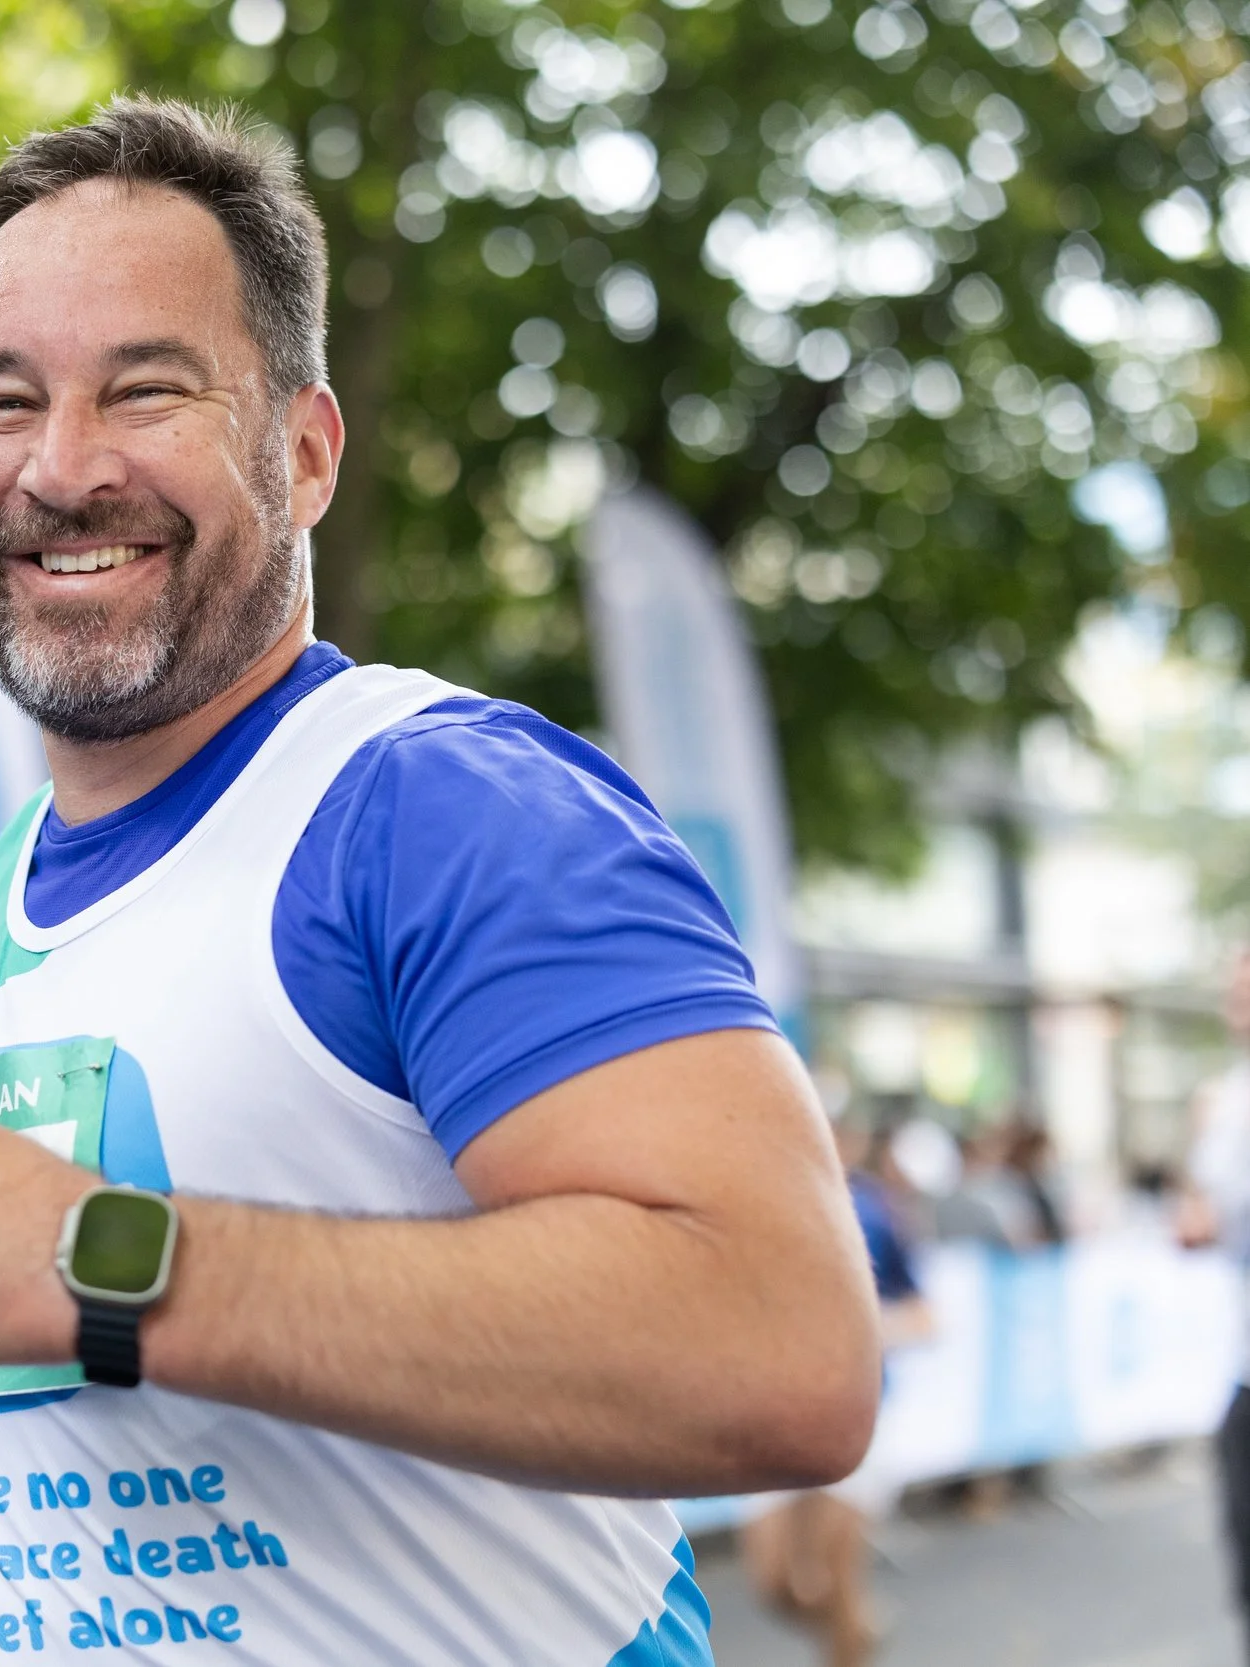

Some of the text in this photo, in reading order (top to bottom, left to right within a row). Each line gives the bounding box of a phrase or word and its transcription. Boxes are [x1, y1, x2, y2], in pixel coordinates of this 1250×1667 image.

[27, 1471, 91, 1511] no
[108, 1464, 226, 1506] one
[104, 1521, 289, 1578] death
[69, 1596, 242, 1649] alone
